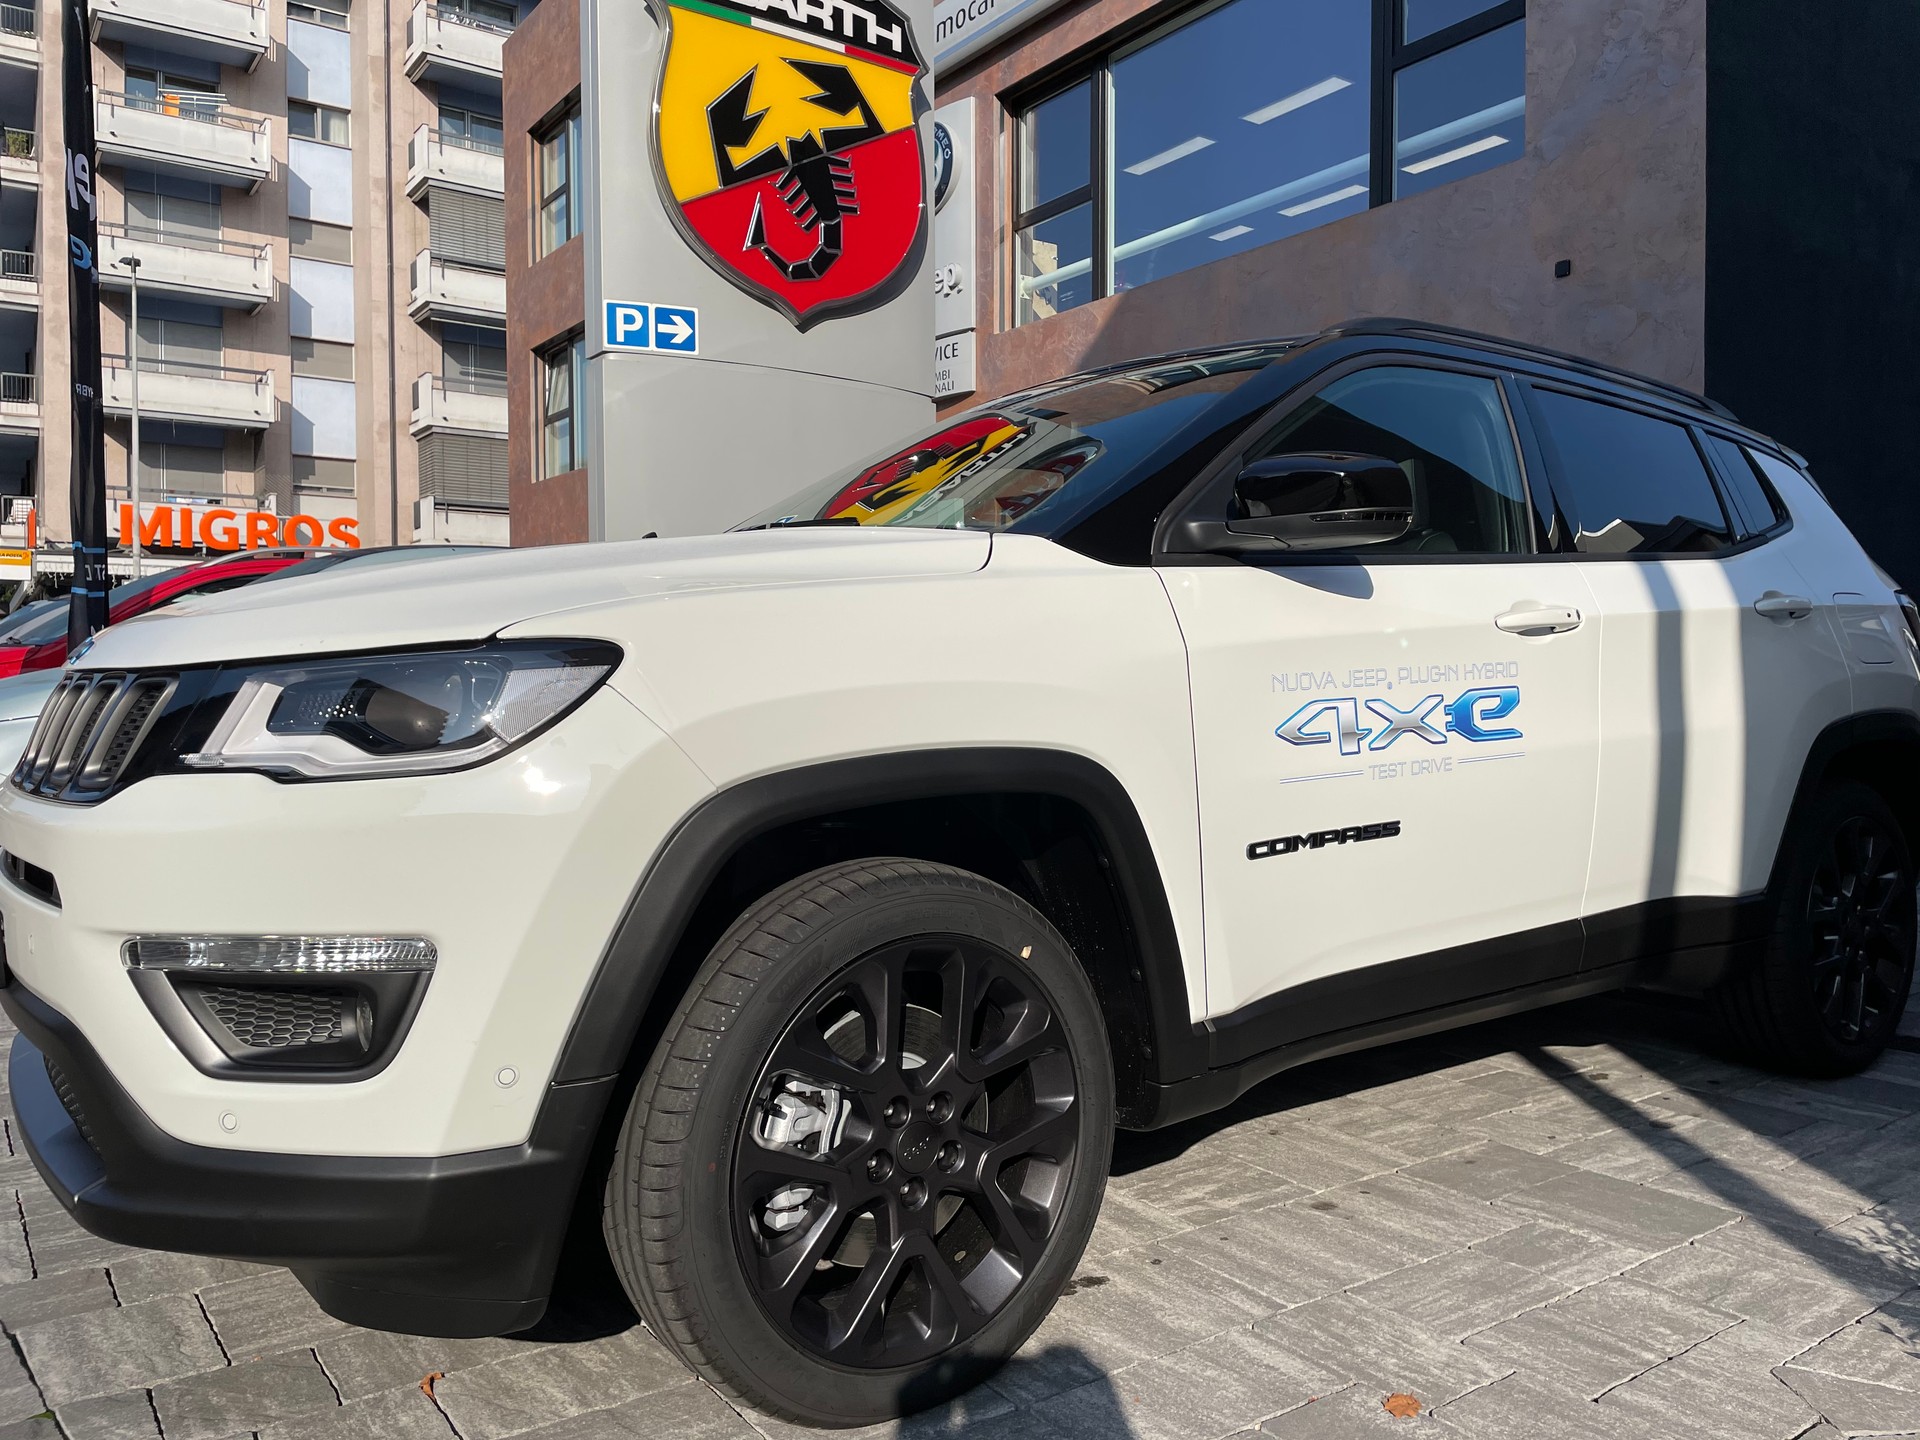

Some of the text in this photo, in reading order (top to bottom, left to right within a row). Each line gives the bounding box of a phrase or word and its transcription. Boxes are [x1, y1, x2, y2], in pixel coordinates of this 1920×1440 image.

[729, 0, 902, 53] ARTH
[616, 307, 643, 342] P
[120, 503, 361, 551] MIGROS
[1271, 671, 1337, 692] NUOVA
[1463, 661, 1519, 680] HYBRID
[1368, 756, 1453, 780] TEST DRIVE
[1246, 820, 1401, 861] COMPASS
